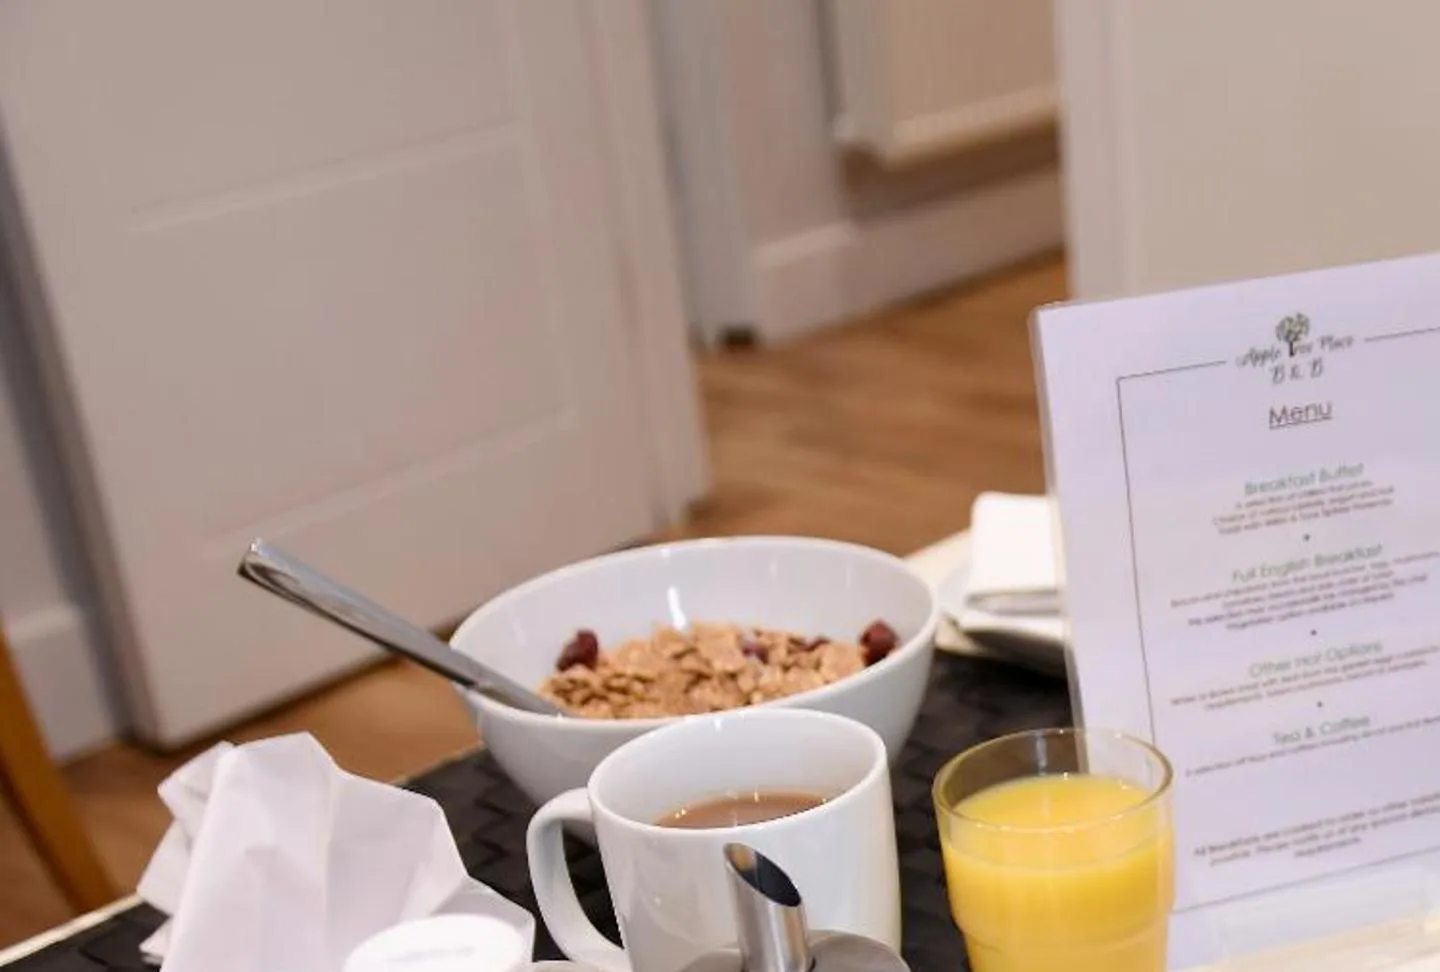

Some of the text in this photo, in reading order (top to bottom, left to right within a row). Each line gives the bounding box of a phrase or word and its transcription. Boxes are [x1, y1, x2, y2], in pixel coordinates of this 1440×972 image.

[1268, 401, 1334, 428] Menu
[1245, 472, 1316, 496] Breakfast
[1319, 462, 1364, 483] Buffet
[1233, 543, 1383, 583] Full English Breakfast
[1248, 641, 1383, 678] Other Hot Options
[1272, 716, 1370, 745] Tea & Coffee
